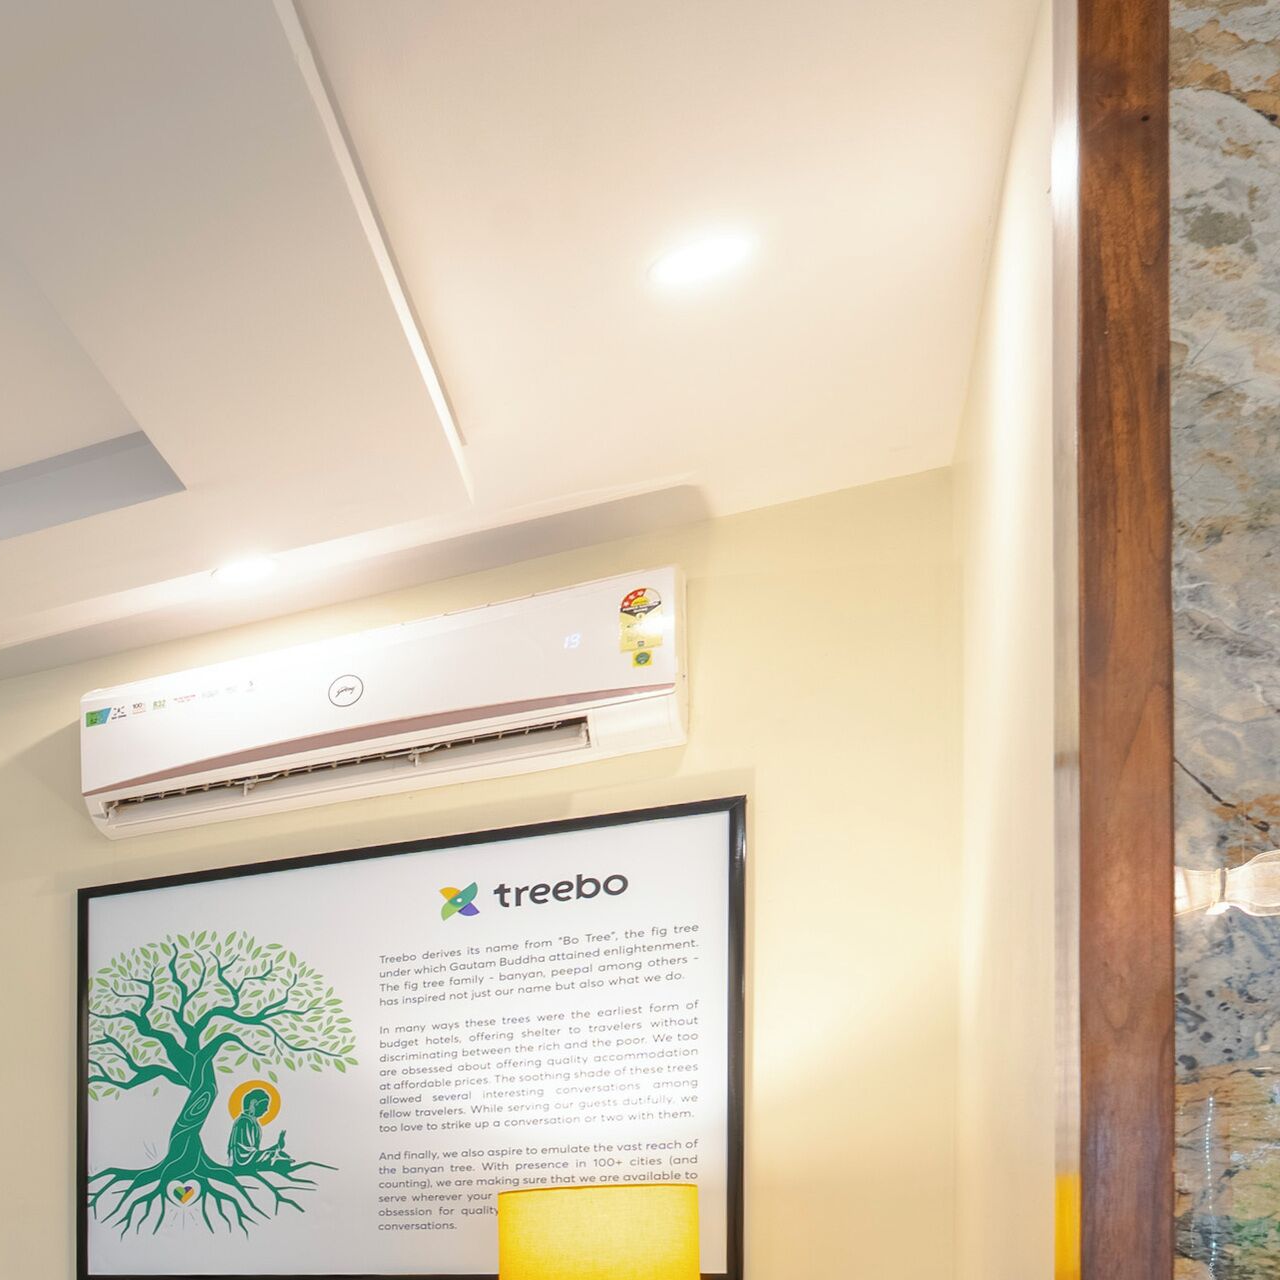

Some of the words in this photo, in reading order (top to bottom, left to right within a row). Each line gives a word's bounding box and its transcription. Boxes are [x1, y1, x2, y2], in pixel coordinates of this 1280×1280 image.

[493, 874, 628, 908] treebo
[378, 951, 417, 963] Treebo
[421, 946, 462, 959] derives
[466, 945, 480, 954] its
[485, 943, 519, 952] name
[524, 937, 552, 949] from
[623, 928, 645, 939] the
[650, 926, 667, 938] fig
[673, 923, 699, 934] tree
[378, 966, 411, 977] under
[413, 962, 447, 974] which
[448, 958, 496, 970] Gautam
[498, 953, 545, 966] Buddha
[548, 948, 600, 961] attained
[602, 938, 698, 958] enlightenment.
[378, 981, 400, 991] The
[403, 979, 418, 991] fig
[422, 977, 445, 987] tree
[448, 973, 484, 987] family
[550, 964, 593, 978] peepal
[597, 961, 642, 974] among
[647, 955, 688, 967] others
[378, 995, 399, 1005] has
[401, 991, 446, 1005] inspired
[448, 989, 468, 999] not
[471, 987, 491, 999] just
[494, 987, 514, 995] our
[517, 984, 552, 993] name
[554, 980, 575, 990] but
[578, 978, 604, 988] also
[607, 975, 639, 986] what
[643, 975, 661, 983] we
[664, 971, 685, 981] do.
[379, 1024, 390, 1033] In
[394, 1024, 426, 1034] many
[431, 1021, 460, 1031] ways
[464, 1016, 496, 1027] these
[501, 1013, 531, 1024] trees
[536, 1013, 565, 1021] were
[570, 1009, 591, 1019] the
[596, 1005, 642, 1017] earliest
[649, 1002, 679, 1013] form
[685, 1000, 699, 1010] of
[378, 1036, 418, 1049] budget
[425, 1033, 461, 1045] hotels,
[468, 1029, 514, 1043] offering
[520, 1026, 561, 1037] shelter
[568, 1024, 581, 1034] to
[588, 1020, 642, 1032] travelers
[649, 1016, 698, 1028] without
[378, 1048, 458, 1063] discriminating
[461, 1044, 511, 1056] between
[514, 1042, 534, 1052] the
[537, 1040, 560, 1050] rich
[563, 1039, 588, 1049] and
[591, 1037, 612, 1047] the
[615, 1037, 648, 1047] poor.
[652, 1033, 673, 1043] We
[676, 1031, 699, 1041] too
[400, 1062, 453, 1074] obsessed
[456, 1060, 491, 1070] about
[495, 1056, 542, 1070] offering
[546, 1053, 588, 1067] quality
[593, 1046, 698, 1062] accommodation
[378, 1080, 391, 1089] at
[392, 1077, 452, 1088] affordable
[454, 1075, 492, 1087] prices.
[493, 1073, 516, 1083] The
[518, 1070, 571, 1083] soothing
[573, 1067, 611, 1078] shade
[613, 1066, 626, 1076] of
[629, 1064, 663, 1075] these
[666, 1062, 699, 1072] trees
[378, 1093, 422, 1103] allowed
[431, 1090, 472, 1100] several
[482, 1086, 544, 1100] interesting
[554, 1080, 641, 1094] conversations
[652, 1079, 698, 1091] among
[378, 1108, 411, 1117] fellow
[414, 1105, 466, 1116] travelers.
[470, 1103, 503, 1113] While
[507, 1101, 550, 1113] serving
[553, 1101, 574, 1109] our
[578, 1097, 618, 1109] guests
[378, 1122, 398, 1132] too
[399, 1121, 423, 1131] love
[425, 1121, 438, 1129] to
[440, 1119, 472, 1129] strike
[474, 1120, 490, 1129] up
[503, 1114, 580, 1126] conversation
[600, 1112, 623, 1121] two
[627, 1110, 654, 1120] with
[657, 1108, 694, 1119] them.
[378, 1151, 401, 1160] And
[403, 1149, 440, 1161] finally,
[460, 1147, 485, 1157] also
[486, 1146, 523, 1158] aspire
[525, 1145, 538, 1154] to
[540, 1143, 590, 1154] emulate
[593, 1142, 614, 1152] the
[616, 1141, 642, 1151] vast
[645, 1140, 682, 1150] reach
[684, 1139, 699, 1149] of
[378, 1165, 397, 1174] the
[401, 1163, 444, 1175] banyan
[449, 1162, 475, 1171] tree.
[481, 1161, 509, 1170] With
[514, 1161, 569, 1171] presence
[575, 1159, 587, 1167] in
[592, 1157, 623, 1167] 100+
[628, 1156, 663, 1165] cities
[668, 1154, 698, 1166] (and
[378, 1178, 433, 1189] counting),
[475, 1175, 520, 1187] making
[549, 1173, 576, 1183] that
[622, 1170, 682, 1181] available
[684, 1170, 698, 1179] to
[410, 1191, 463, 1201] wherever
[466, 1193, 493, 1201] your
[377, 1206, 432, 1216] obsession
[438, 1206, 455, 1215] for
[377, 1221, 457, 1231] conversations.
